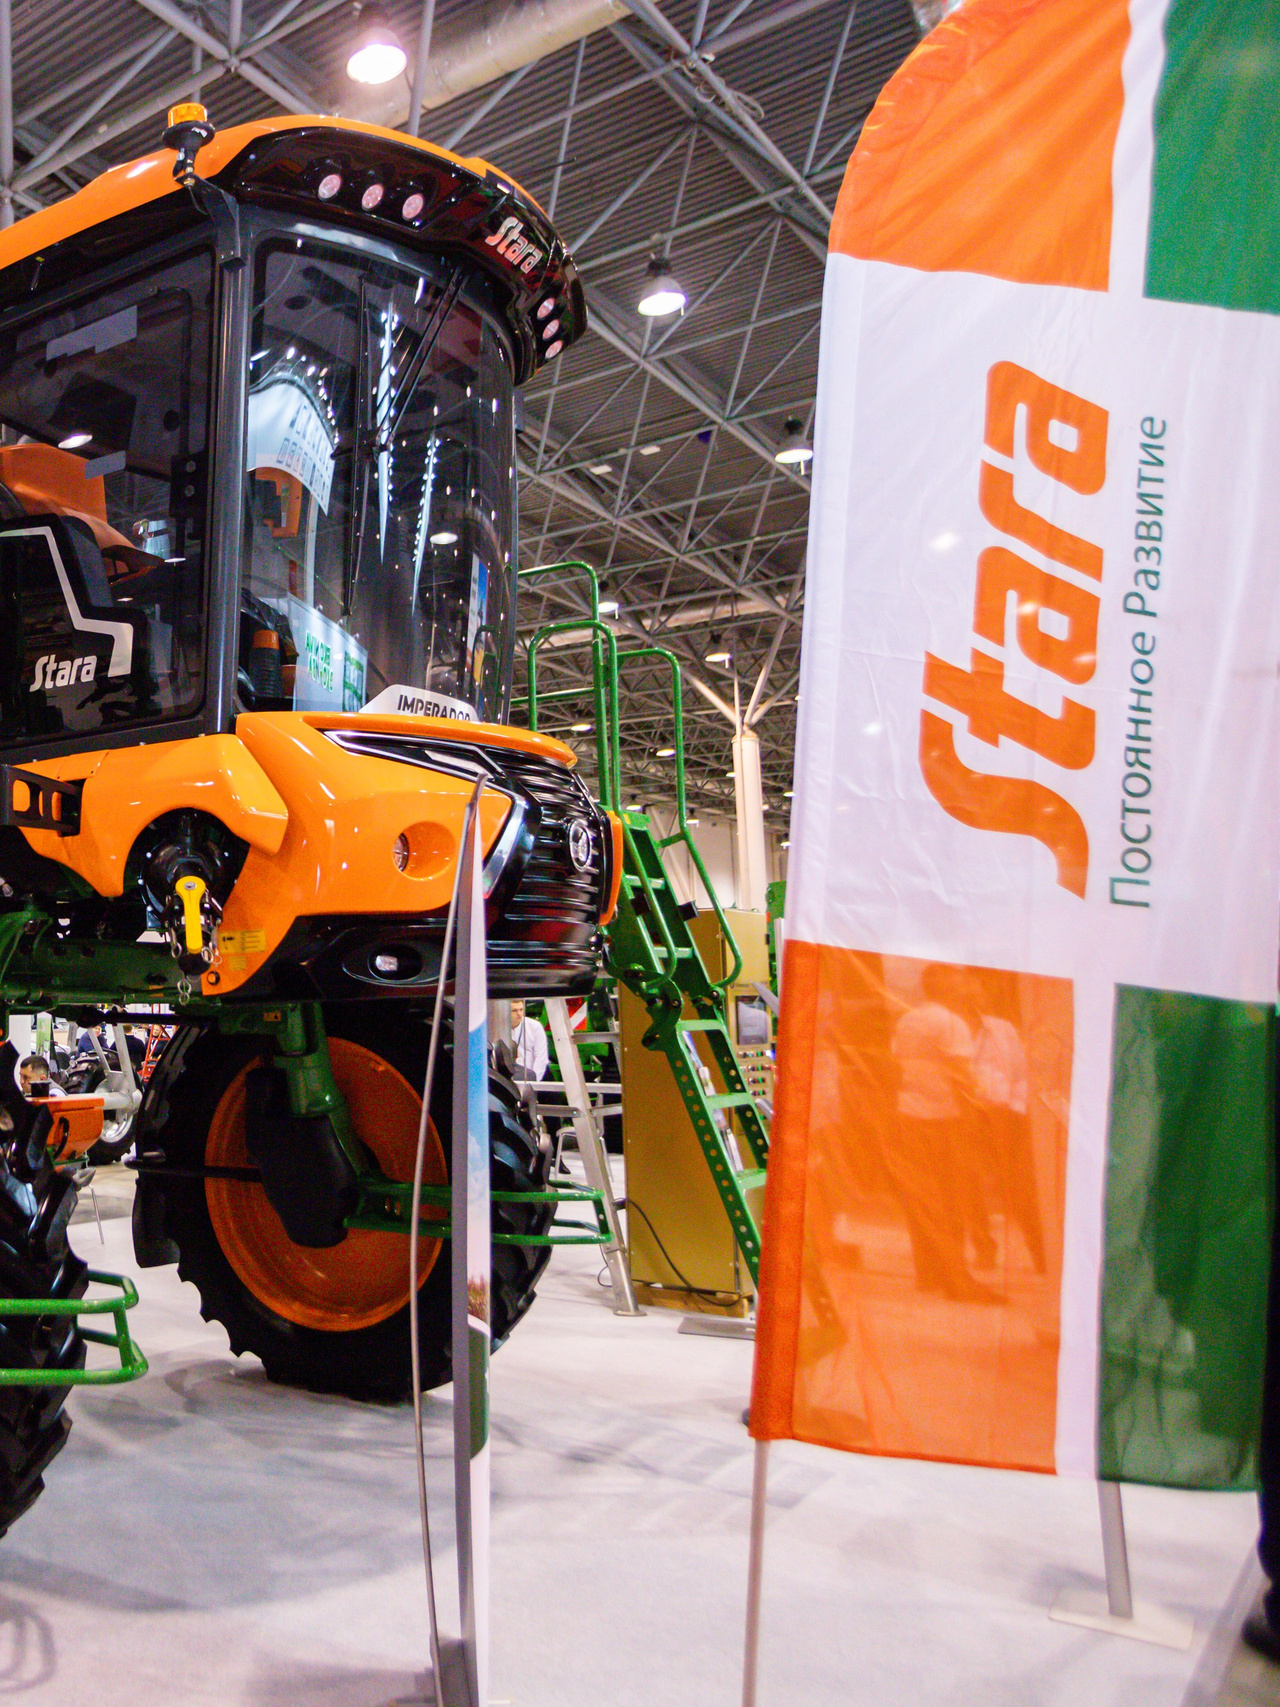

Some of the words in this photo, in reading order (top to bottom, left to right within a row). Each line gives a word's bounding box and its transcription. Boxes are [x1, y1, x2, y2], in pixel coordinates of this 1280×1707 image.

[484, 216, 543, 274] Stara
[1122, 415, 1167, 618] Развитие
[29, 654, 98, 692] Stara
[918, 360, 1109, 901] Stara
[1109, 631, 1157, 908] Постоянное
